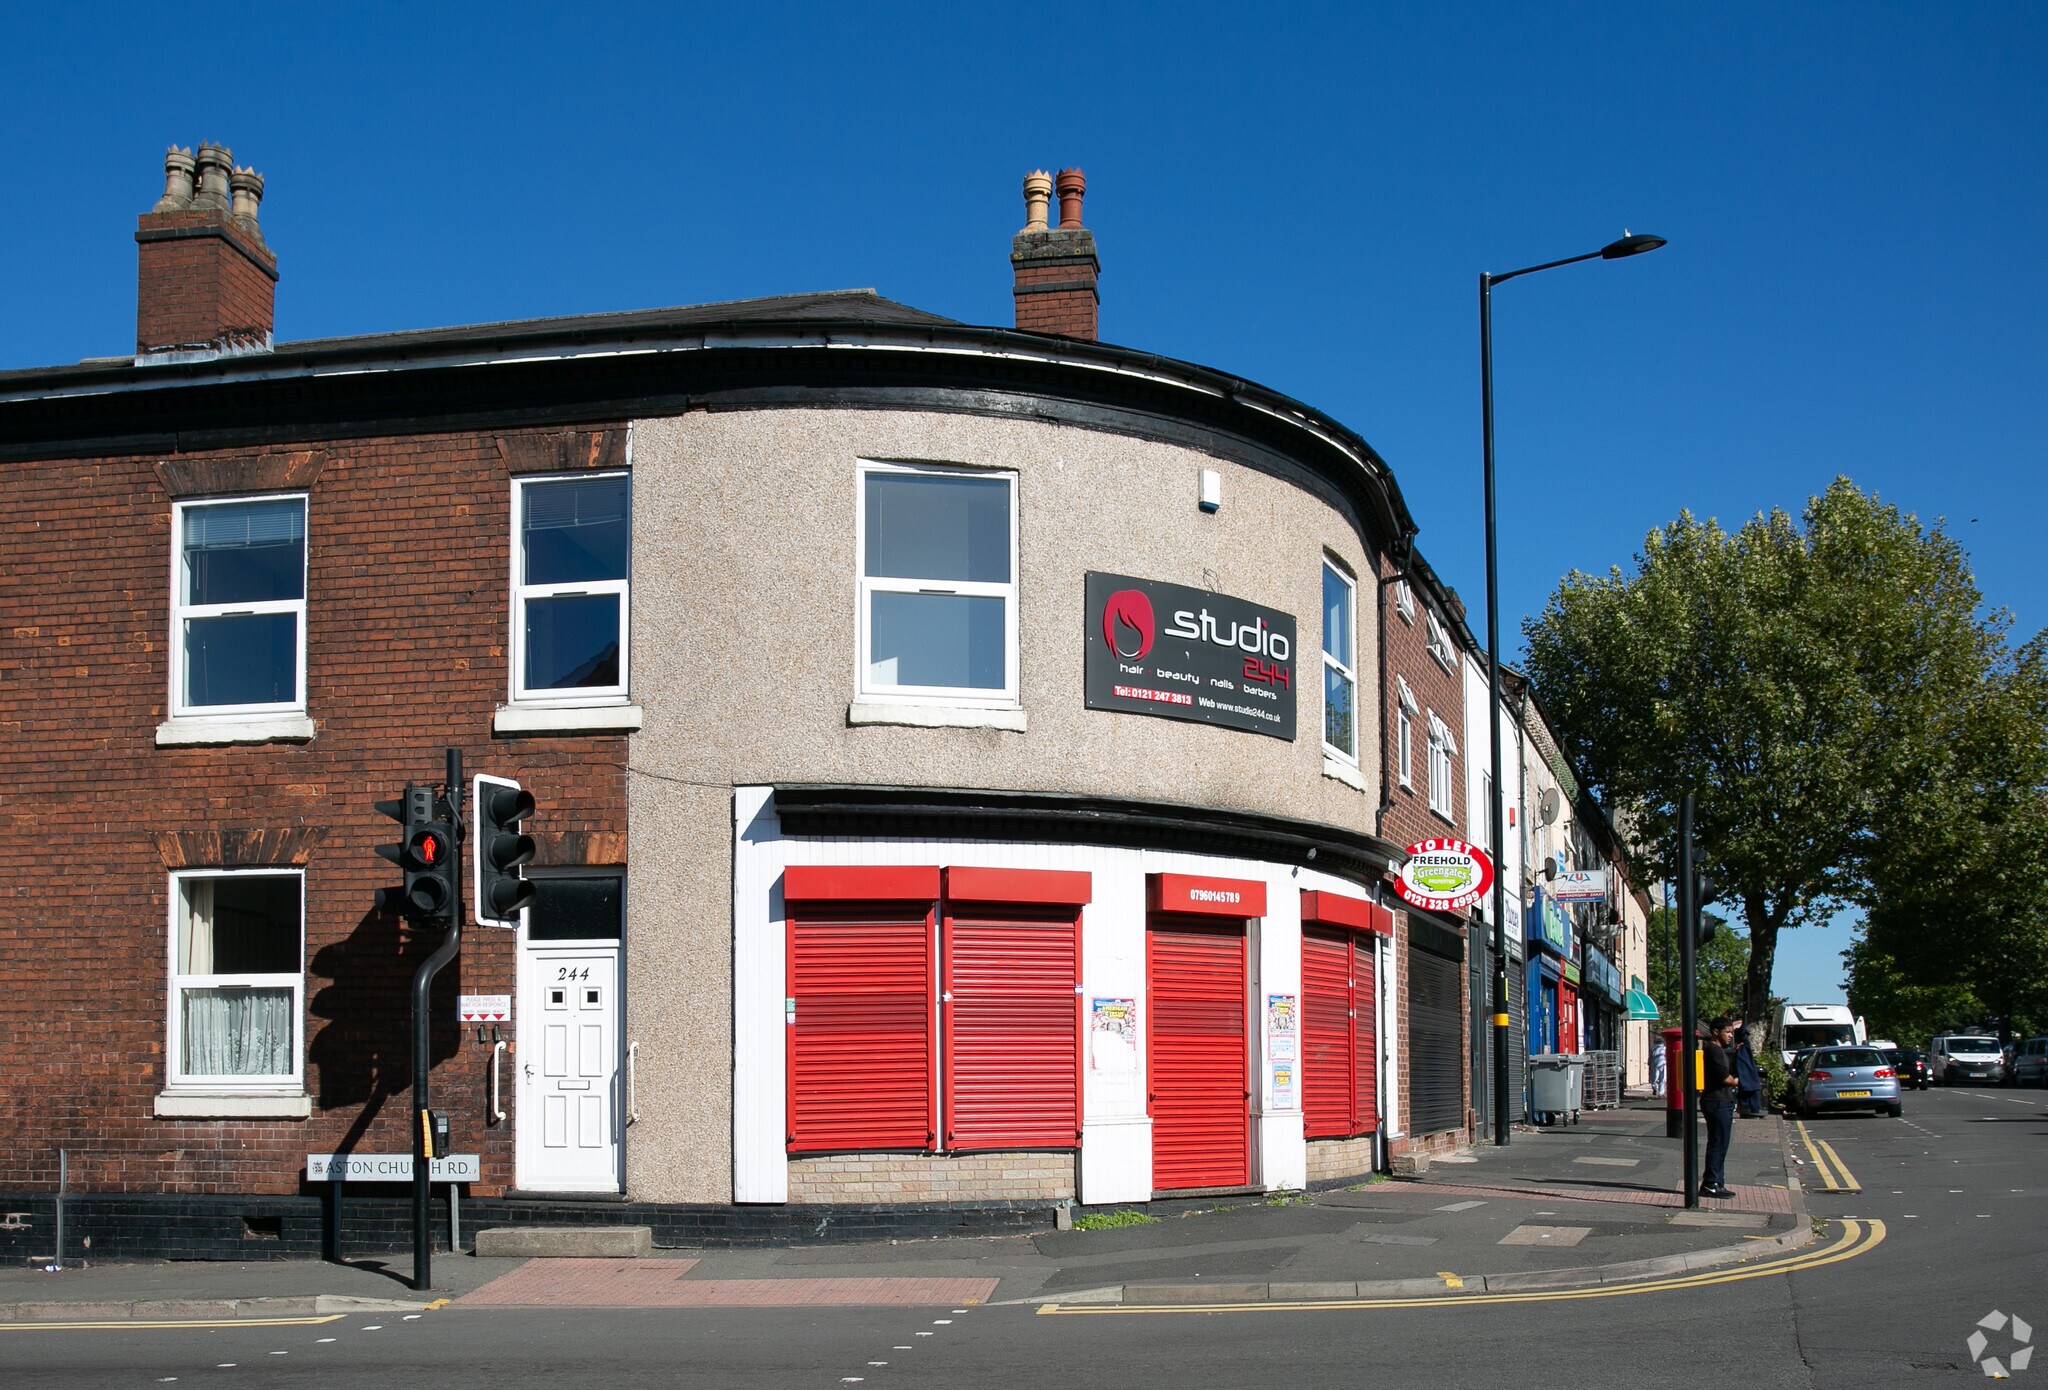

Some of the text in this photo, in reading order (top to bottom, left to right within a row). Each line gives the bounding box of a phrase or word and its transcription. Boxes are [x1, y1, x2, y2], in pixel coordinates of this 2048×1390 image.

[1164, 608, 1289, 661] studio
[1120, 663, 1277, 700] hair beauty nails barbers
[1243, 656, 1289, 690] 244
[1115, 686, 1192, 705] Tel: 0121 247 3813
[1199, 696, 1281, 723] Web www.studio244.co.uk
[1414, 838, 1473, 855] TO LET
[1413, 856, 1471, 865] FREEHOLD
[1417, 867, 1467, 879] Greengates
[1190, 889, 1240, 903] 07960145789
[1403, 889, 1427, 907] 0121
[1428, 899, 1450, 910] 328
[1452, 890, 1480, 908] 4999
[557, 966, 590, 981] 244
[325, 1161, 373, 1174] ASTON
[378, 1161, 441, 1174] CHUH
